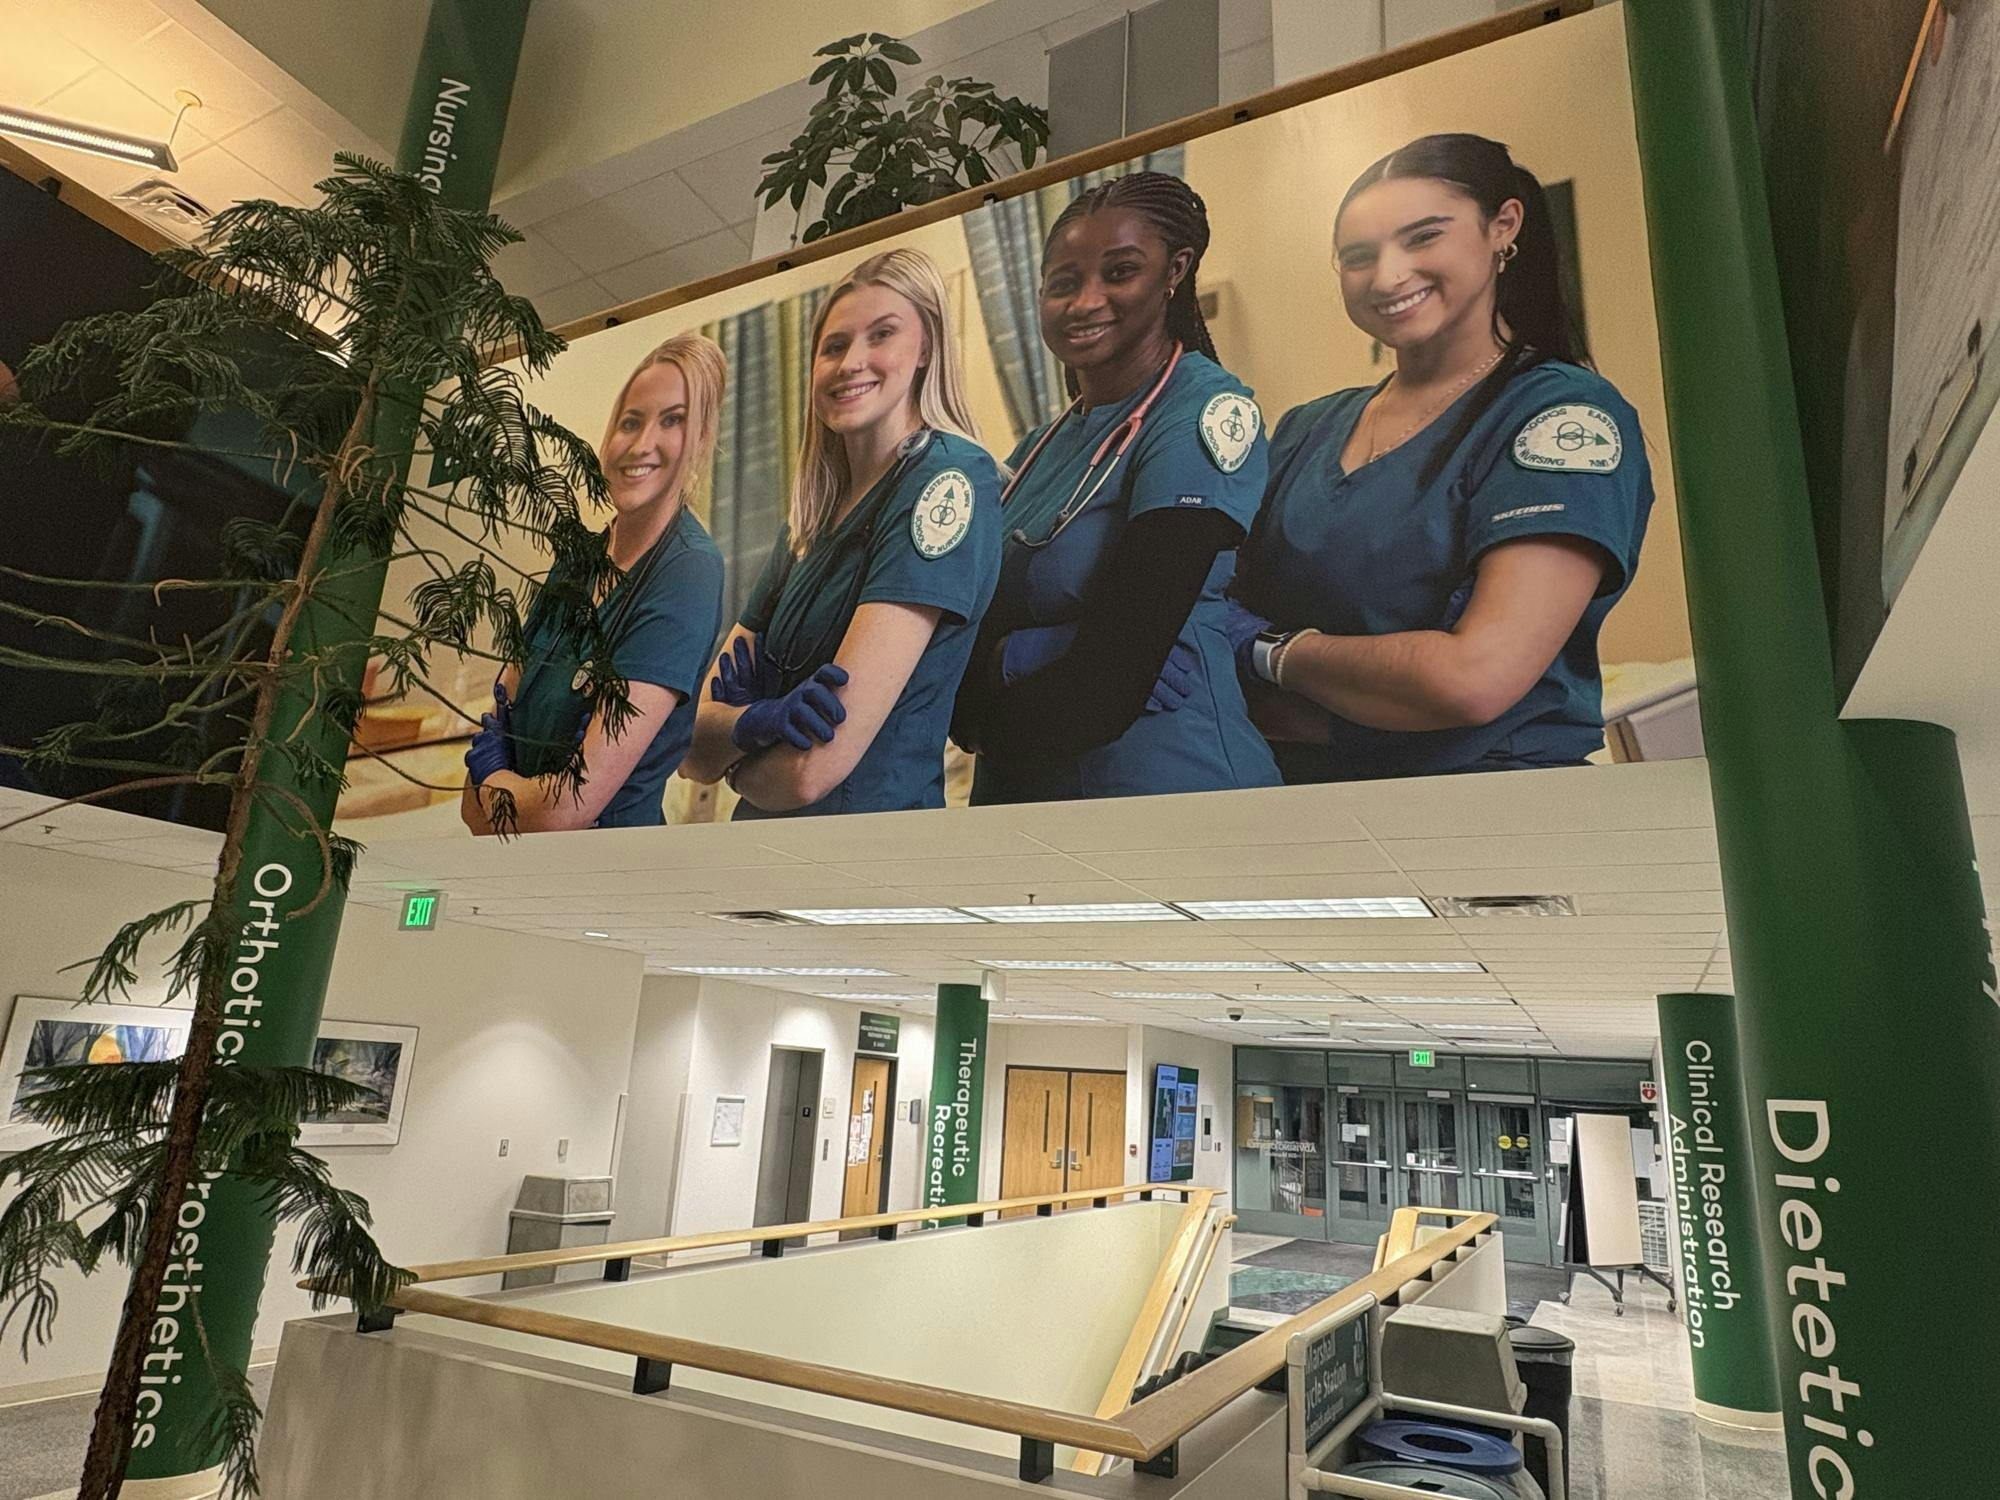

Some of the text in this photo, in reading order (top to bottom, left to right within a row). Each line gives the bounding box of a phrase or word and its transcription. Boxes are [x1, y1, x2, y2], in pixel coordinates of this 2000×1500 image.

[413, 77, 471, 195] Nursing
[1519, 448, 1567, 467] NURSING
[1521, 407, 1568, 434] SCHOOL
[405, 897, 436, 926] EXIT
[952, 1037, 977, 1178] Therapeutic
[1413, 1051, 1431, 1065] EXIT
[927, 1104, 952, 1231] Recreatin
[1685, 1040, 1741, 1312] Clinical Research
[1669, 1112, 1708, 1349] Administration
[1766, 1099, 1876, 1500] Dietetic
